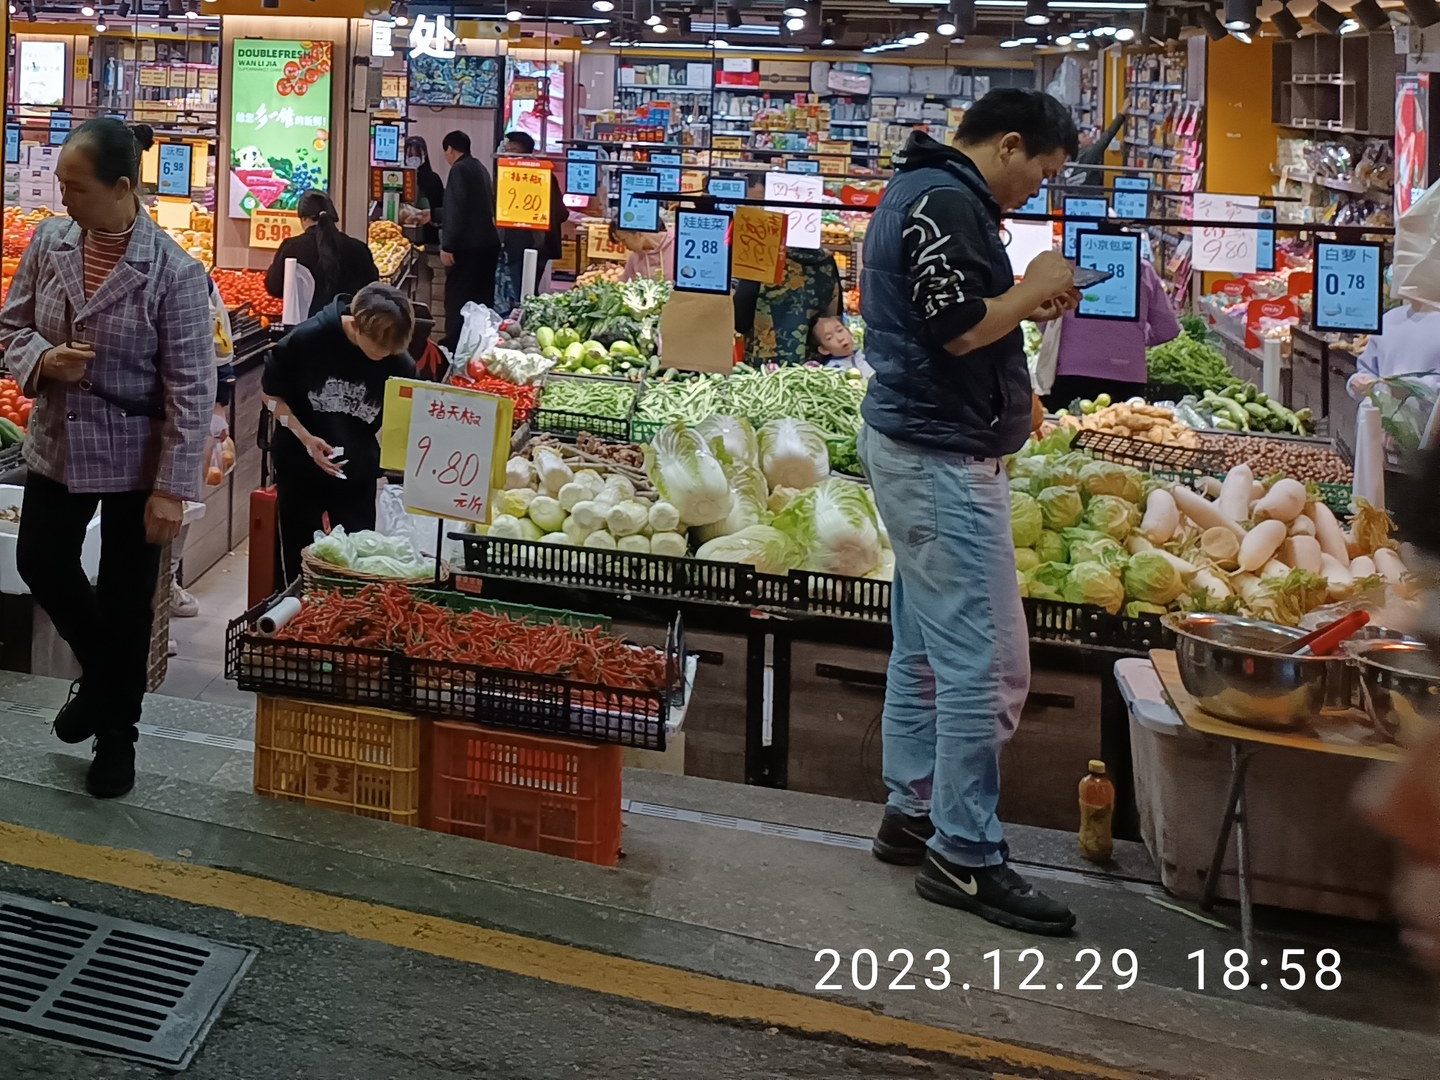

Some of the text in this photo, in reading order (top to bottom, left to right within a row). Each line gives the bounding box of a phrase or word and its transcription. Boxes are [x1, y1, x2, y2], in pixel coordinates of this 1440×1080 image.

[162, 161, 185, 176] 6.98
[507, 187, 542, 211] 9.80
[255, 223, 292, 241] 6.98
[682, 215, 725, 231] 娃娃菜
[684, 238, 719, 260] 2.88
[1084, 240, 1133, 252] 小京包菜
[1325, 247, 1373, 263] 白萝卜
[1325, 273, 1366, 296] 0.78
[428, 399, 482, 427] 指天椒
[415, 435, 480, 487] 9.80
